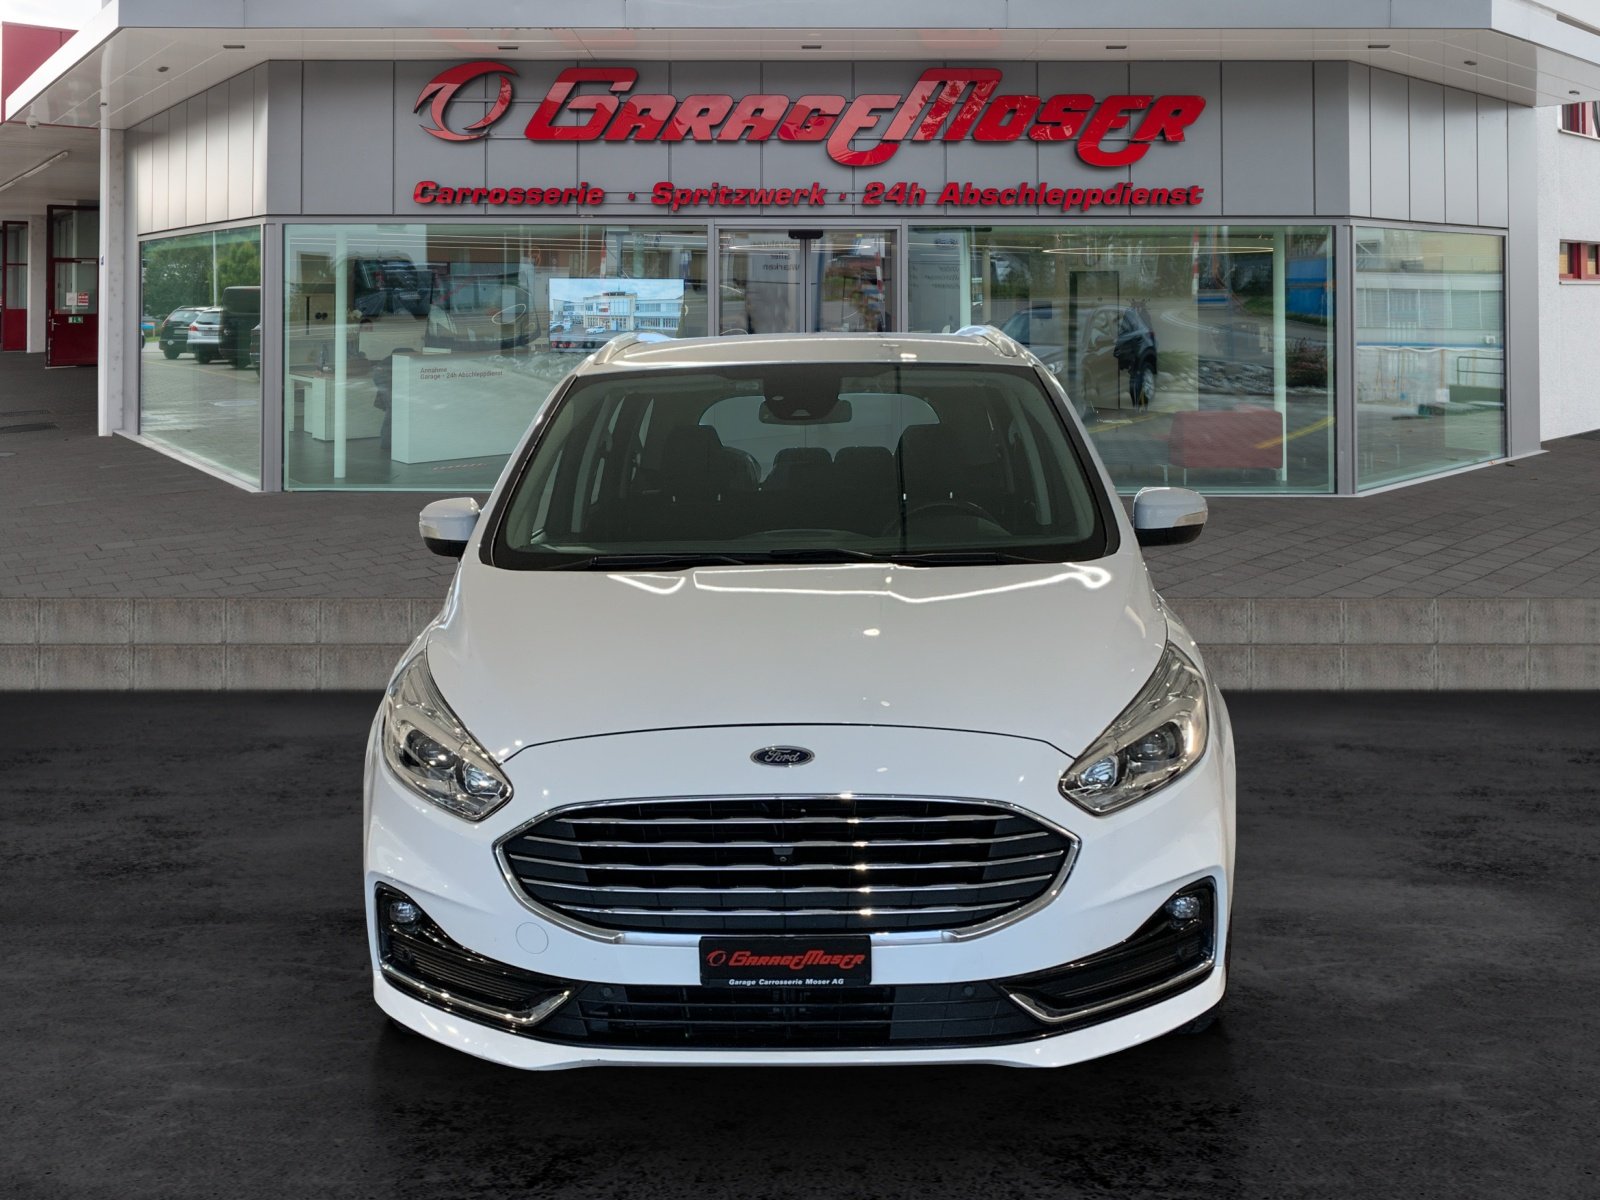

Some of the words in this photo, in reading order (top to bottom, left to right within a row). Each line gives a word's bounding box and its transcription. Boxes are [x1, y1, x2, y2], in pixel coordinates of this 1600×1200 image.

[413, 180, 605, 206] Carrosserie
[651, 181, 826, 211] Spritzwerk
[862, 181, 926, 206] 24h
[936, 181, 1204, 212] Abschleppdienst
[764, 749, 801, 762] Ford
[728, 978, 756, 986] Garage
[758, 978, 803, 986] Carrosserie
